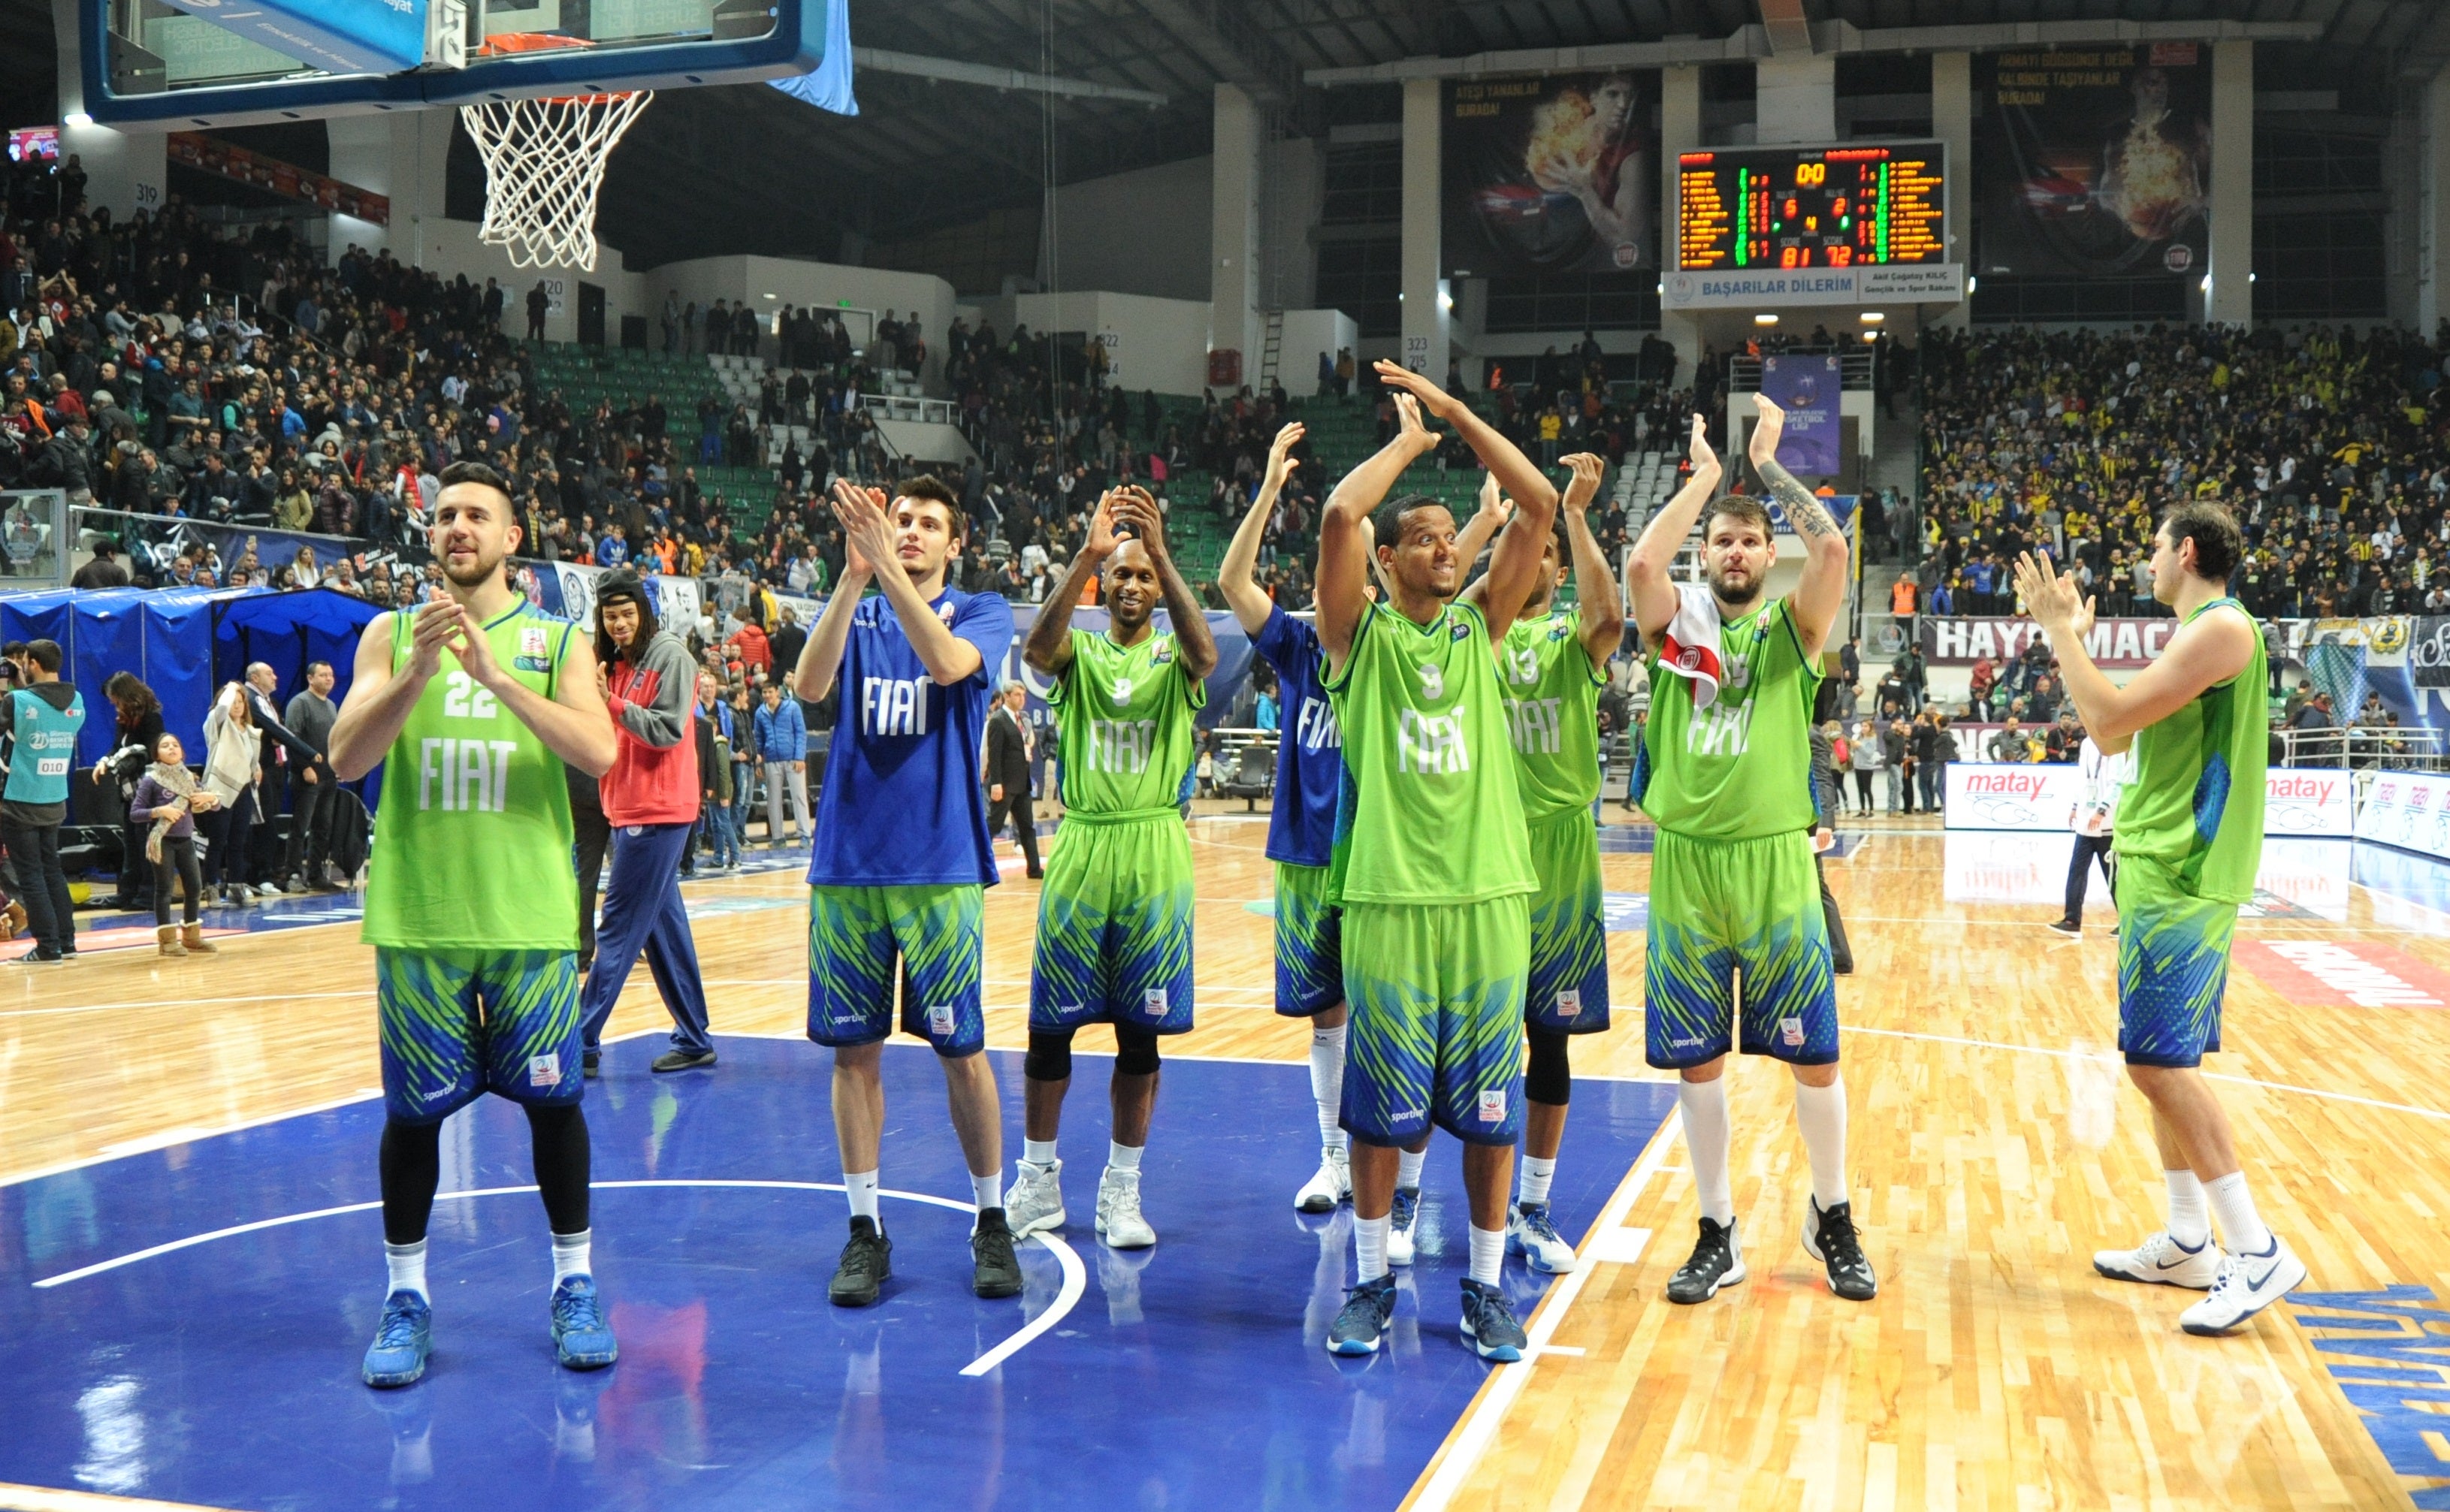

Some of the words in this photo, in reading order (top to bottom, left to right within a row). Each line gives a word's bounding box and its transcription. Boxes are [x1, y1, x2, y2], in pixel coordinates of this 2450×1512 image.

[137, 183, 157, 203] 319
[1781, 237, 1800, 247] SCORE
[1823, 237, 1843, 246] SCORE
[1780, 247, 1810, 270] 81
[1826, 246, 1852, 268] 72
[1702, 279, 1786, 297] BAŞARILAR
[1791, 277, 1852, 292] DİLERİM
[1508, 648, 1539, 685] 13
[1418, 663, 1443, 700] 9
[444, 670, 497, 719] 22
[862, 675, 934, 736] FIAT
[1088, 718, 1156, 774] FIAT
[1397, 705, 1470, 774] FIAT
[41, 762, 63, 773] 010
[419, 738, 517, 813] FIAT
[1966, 771, 2047, 801] matay
[1672, 1037, 1705, 1048] sportive
[1391, 1109, 1424, 1122] sportive
